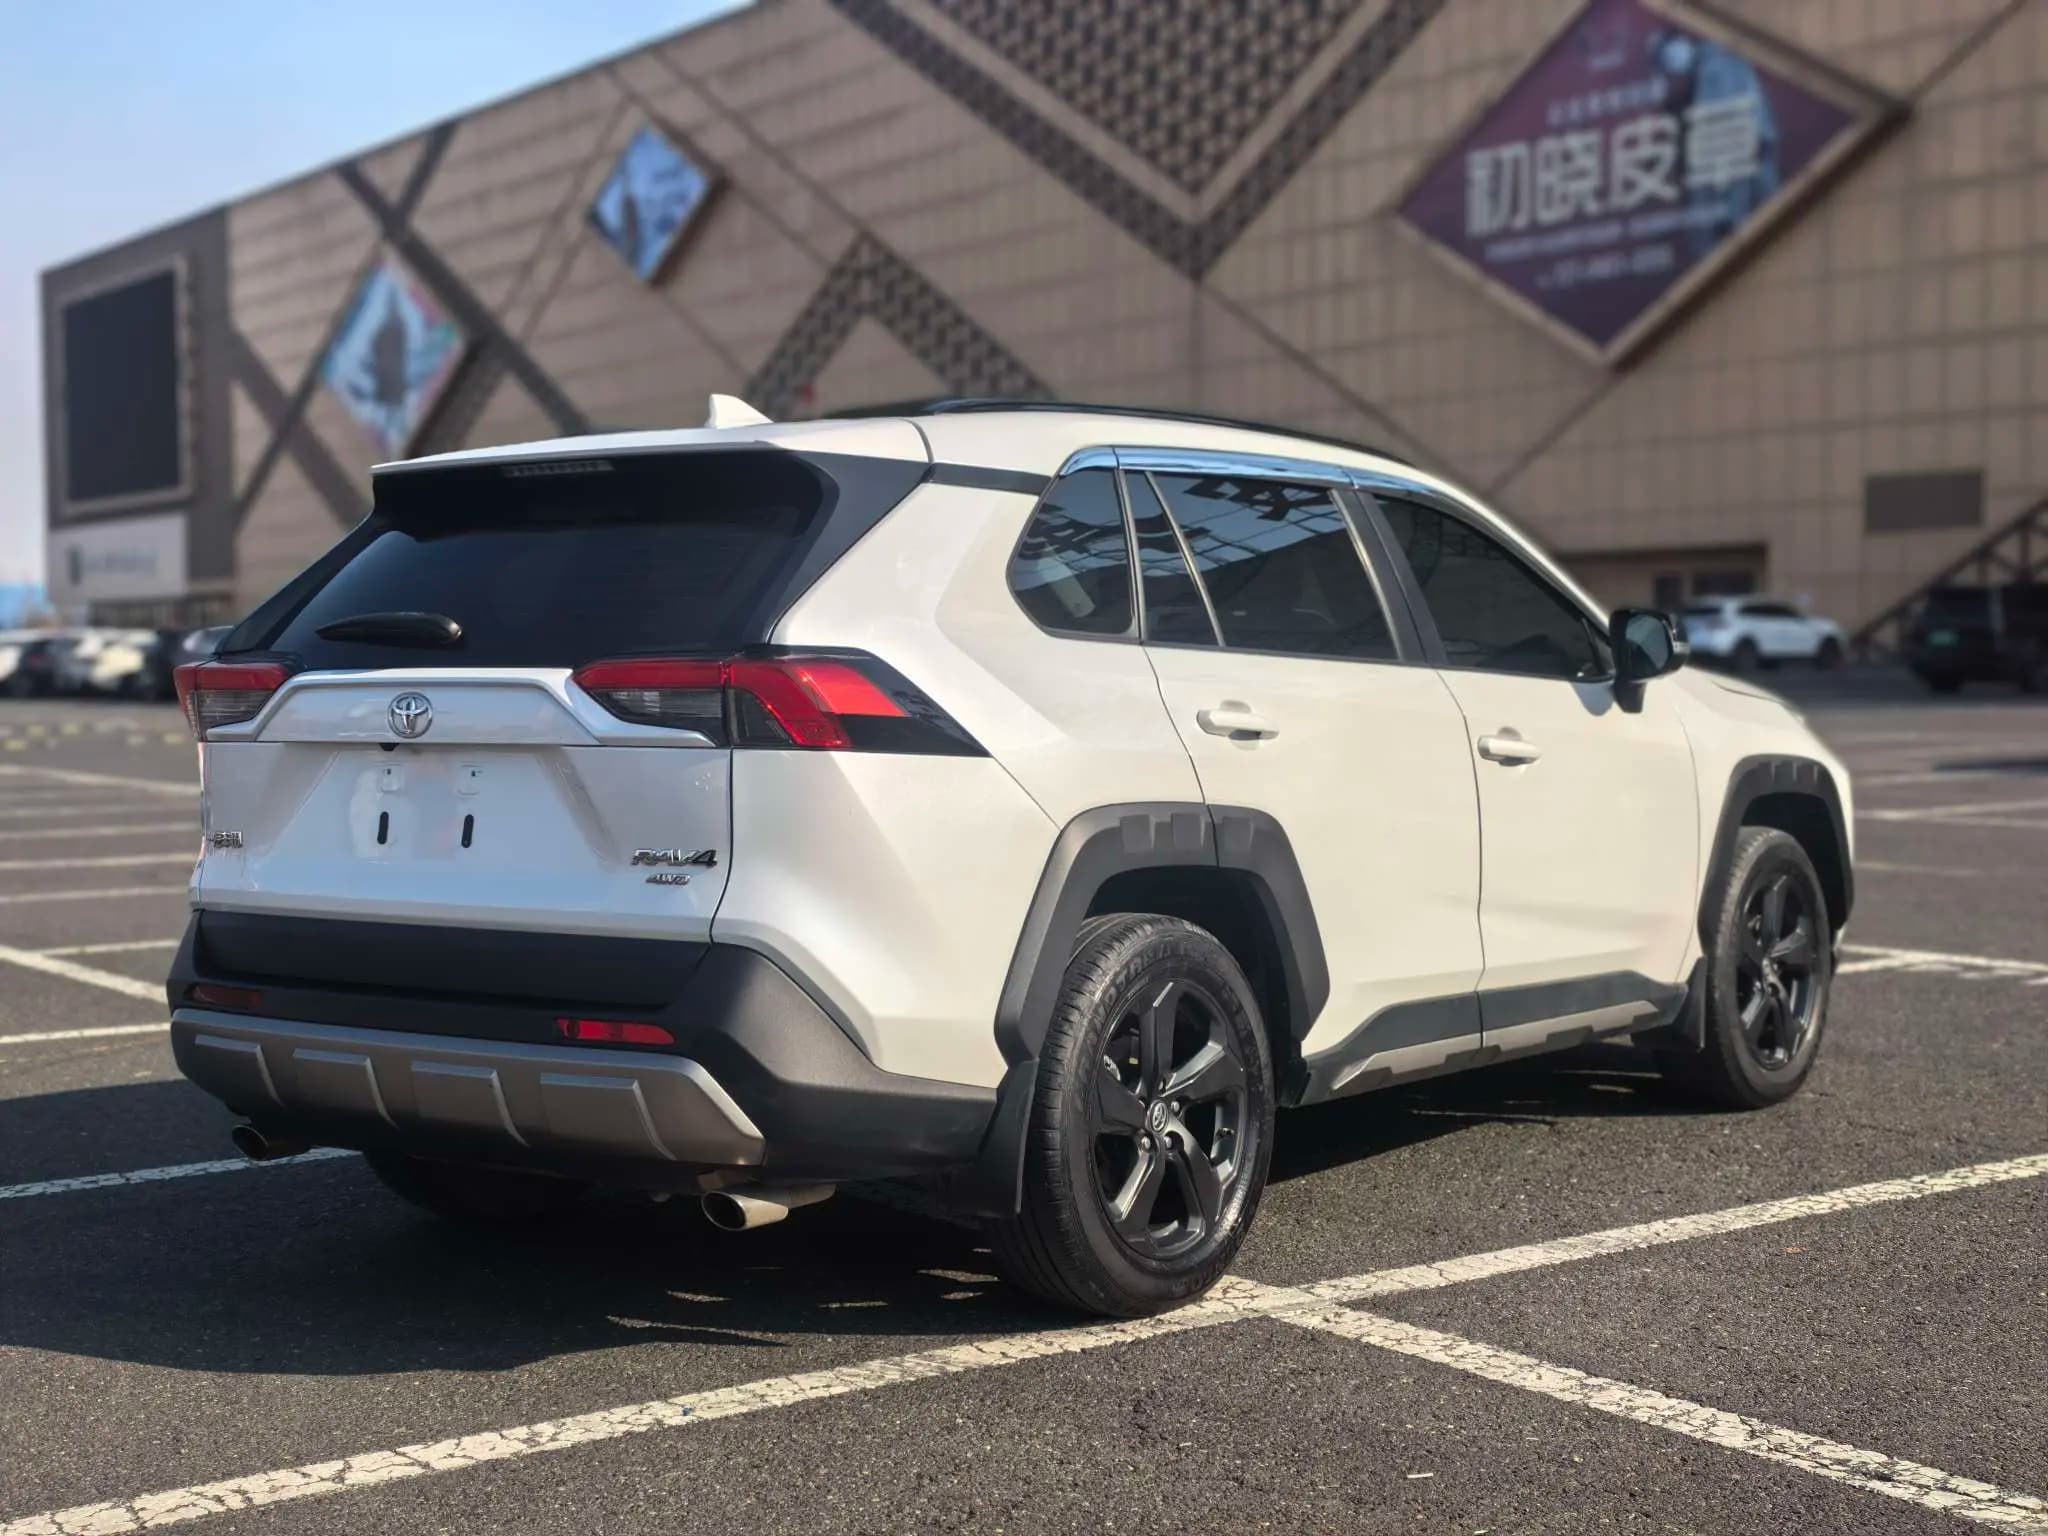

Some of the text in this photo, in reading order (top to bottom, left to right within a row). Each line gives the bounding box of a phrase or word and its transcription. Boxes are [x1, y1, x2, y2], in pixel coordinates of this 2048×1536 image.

[1464, 91, 1761, 239] 初晓皮草
[631, 848, 718, 868] RAV4
